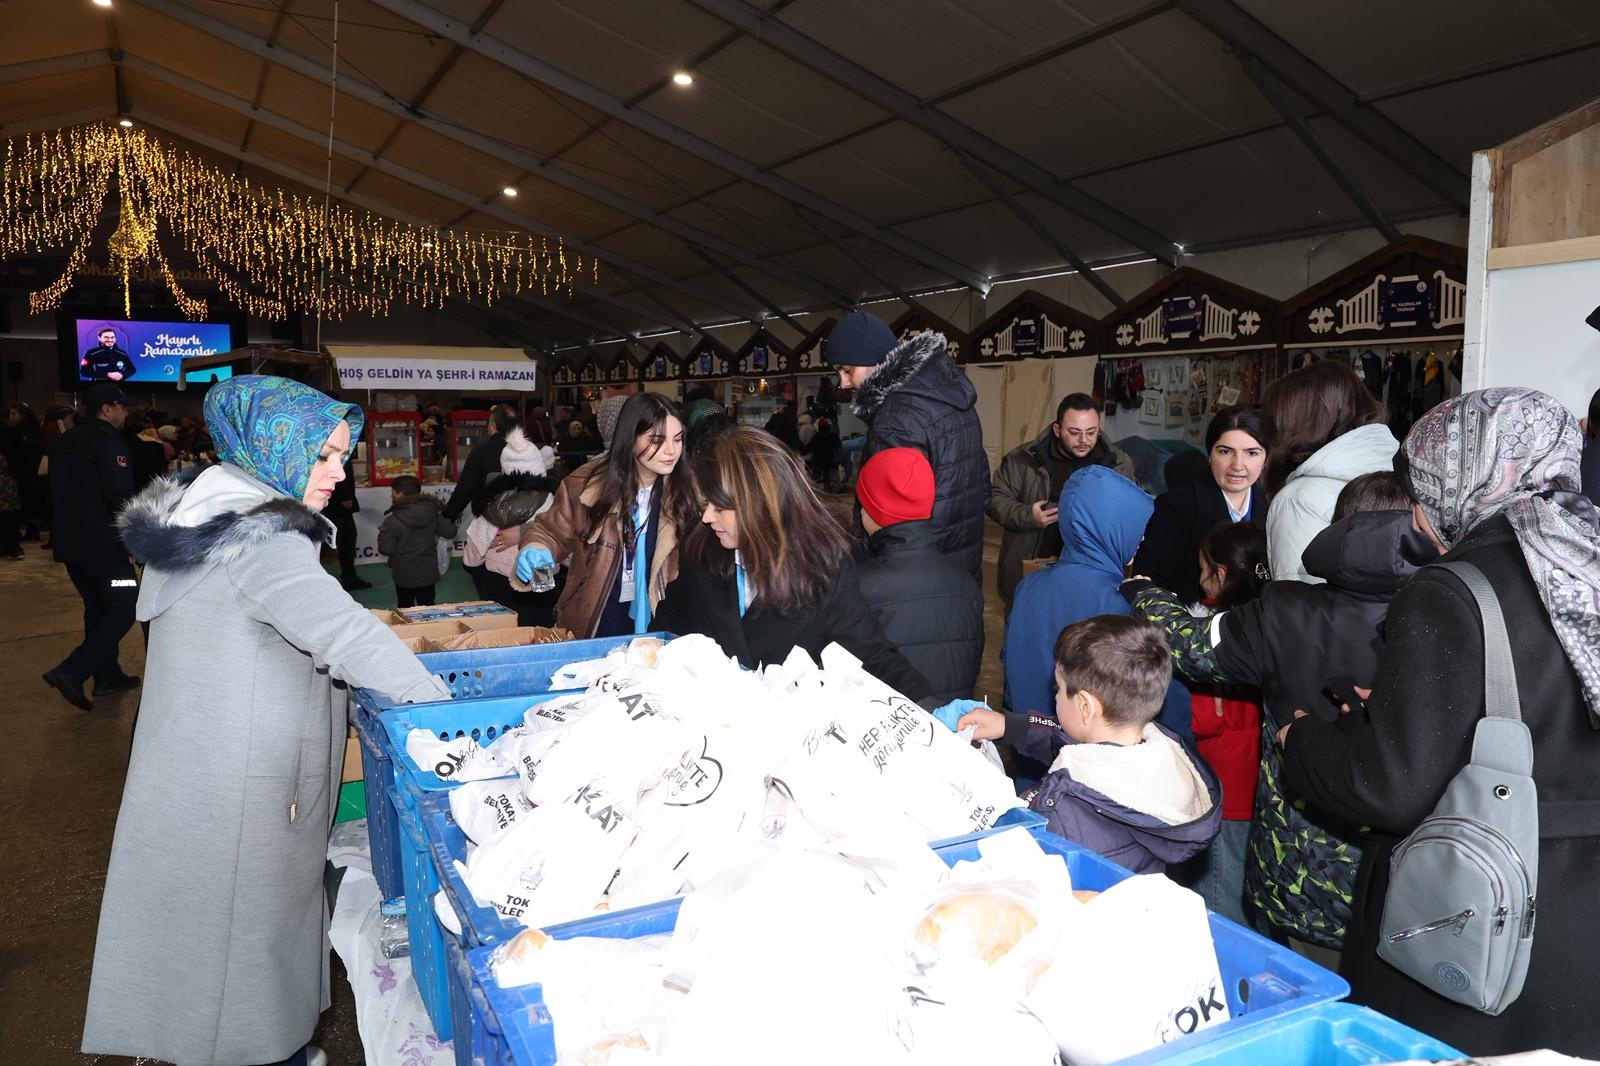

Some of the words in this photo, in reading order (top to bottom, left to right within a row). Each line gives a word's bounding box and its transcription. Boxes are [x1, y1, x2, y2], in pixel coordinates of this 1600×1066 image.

[155, 333, 202, 347] Hayırlı
[140, 342, 218, 358] Ramazanlar
[367, 367, 413, 379] GELDİN
[417, 369, 432, 379] YA
[436, 368, 475, 381] ŞEHR-İ
[479, 370, 534, 381] RAMAZAN
[1168, 986, 1225, 1035] OK
